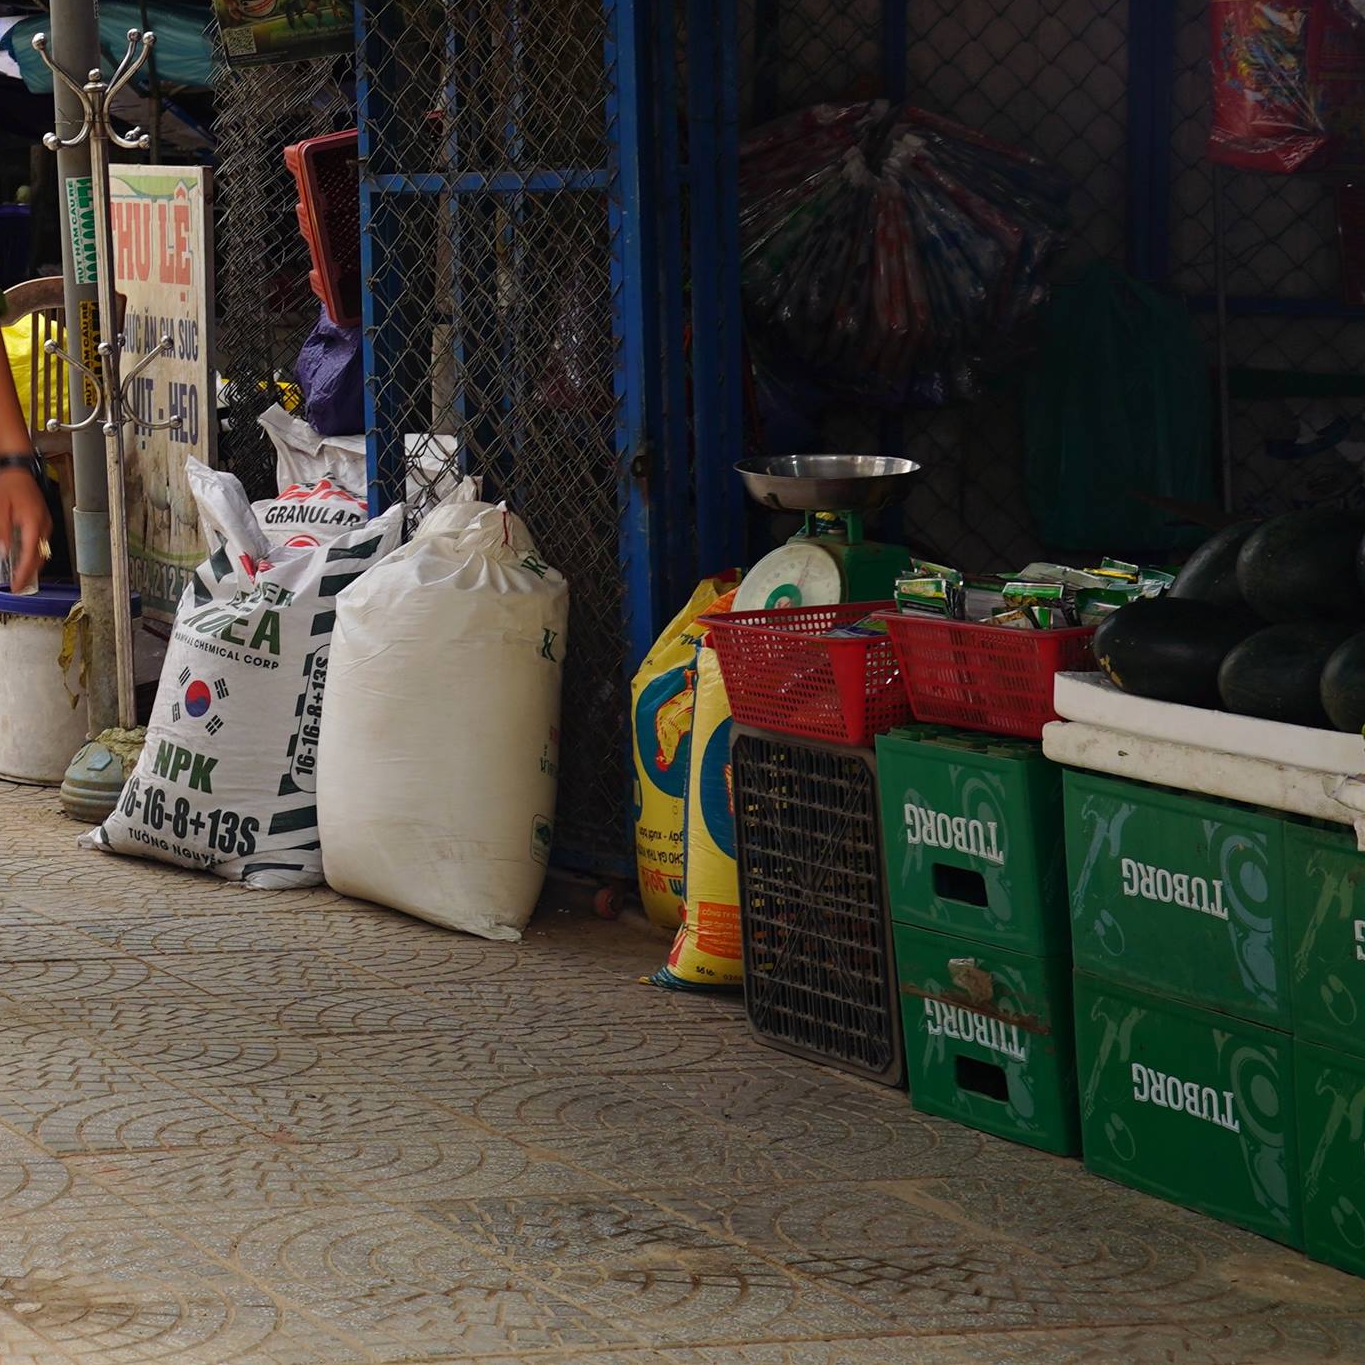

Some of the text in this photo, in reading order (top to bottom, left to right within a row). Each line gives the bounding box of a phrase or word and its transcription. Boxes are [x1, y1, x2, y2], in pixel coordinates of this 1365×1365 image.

[158, 186, 191, 302] LỆ
[178, 309, 199, 362] SÚC
[168, 381, 198, 445] HEO
[265, 504, 361, 527] GRANULAR
[182, 608, 281, 656] KOEA
[193, 639, 240, 662] CHEMICAL
[243, 654, 280, 671] CORP
[152, 738, 219, 795] NPK
[120, 775, 260, 858] 16-16-8+13S
[904, 803, 1005, 867] TUBORG
[1122, 858, 1229, 921] TUBORG
[924, 997, 1027, 1063] TUBORG
[1132, 1063, 1241, 1134] TUBORG
